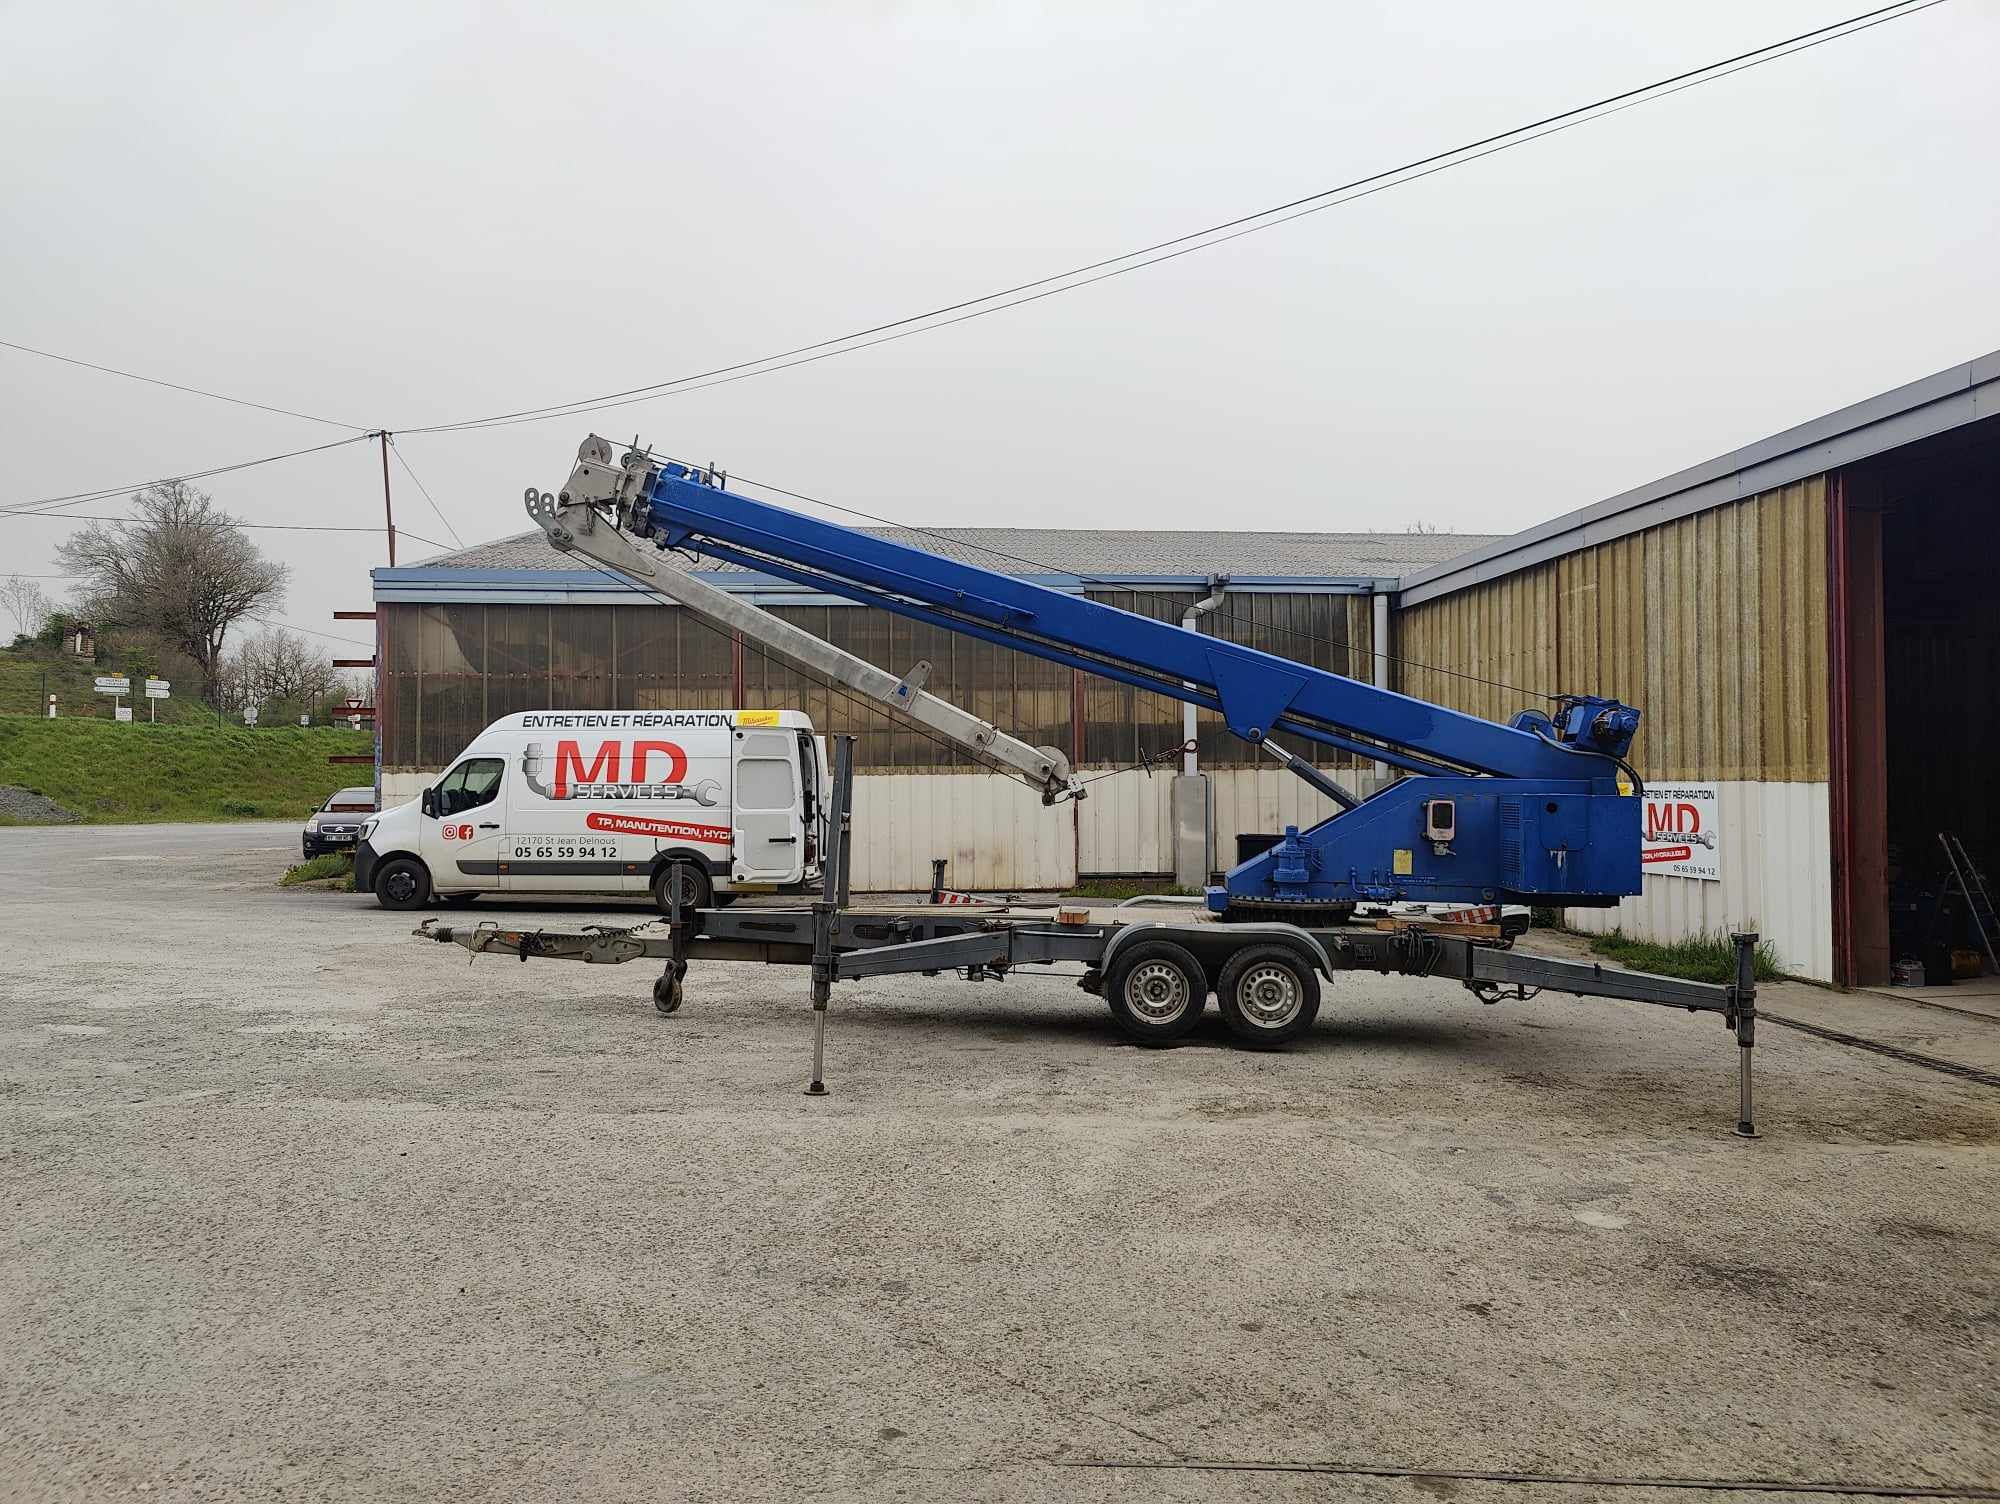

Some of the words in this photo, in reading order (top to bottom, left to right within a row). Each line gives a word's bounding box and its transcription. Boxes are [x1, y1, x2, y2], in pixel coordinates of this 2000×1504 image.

[522, 715, 609, 727] ENTRETIEN
[611, 715, 630, 726] ET
[633, 712, 732, 727] RÉPARATION
[554, 740, 688, 799] MD
[576, 784, 678, 799] SERVICES
[597, 817, 614, 828] TP,
[616, 819, 702, 838] MANUTENTION,
[1648, 803, 1700, 841] MD
[517, 836, 543, 844] 12170
[545, 836, 554, 844] St
[556, 836, 577, 845] Jean
[579, 836, 616, 844] Delnous
[515, 847, 531, 857] 05
[536, 847, 552, 857] 65
[558, 847, 574, 857] 59
[579, 847, 595, 857] 94
[601, 847, 617, 857] 12
[1673, 864, 1681, 872] 05
[1708, 867, 1716, 876] 12
